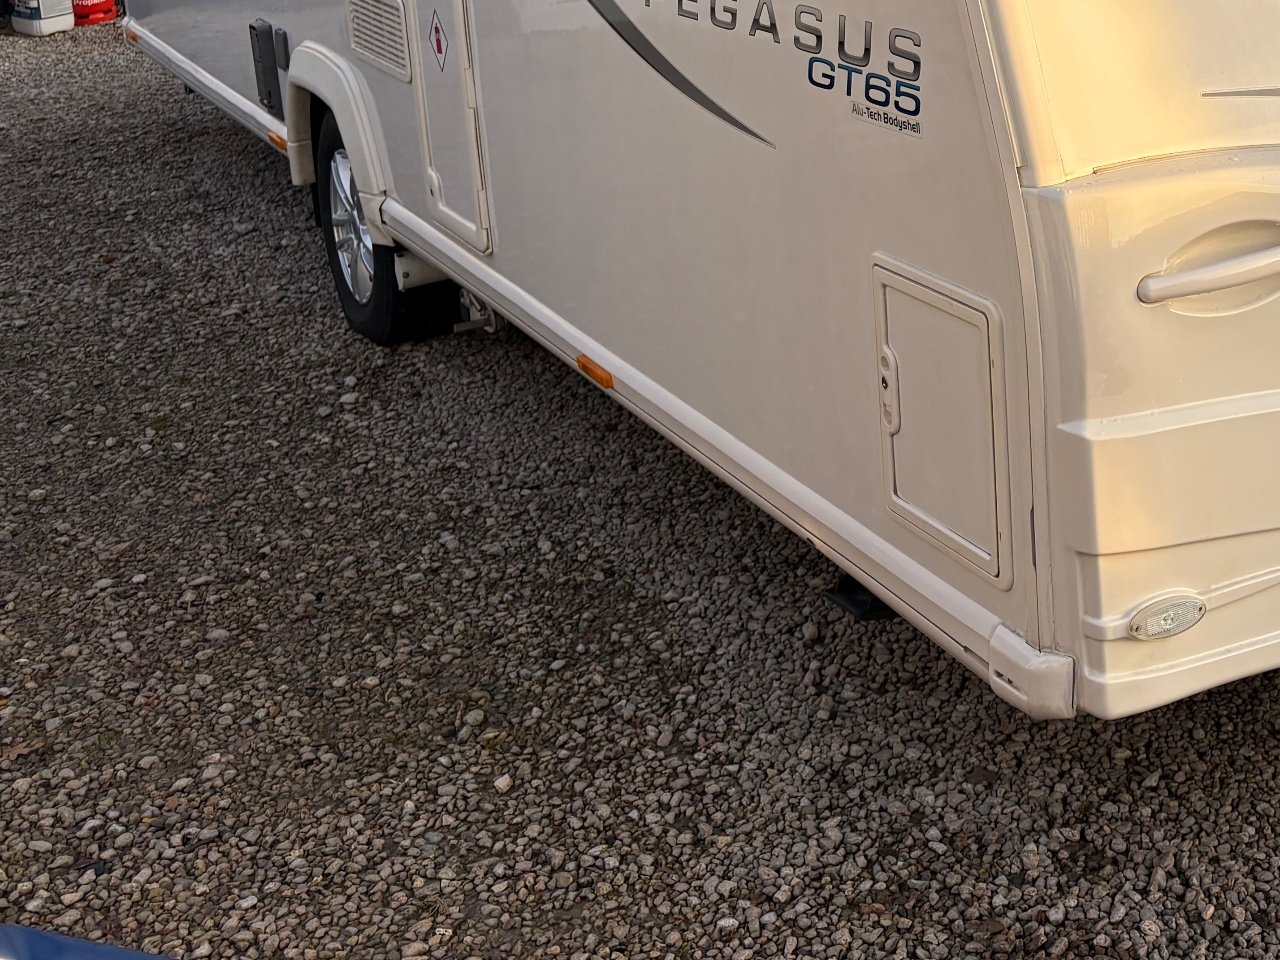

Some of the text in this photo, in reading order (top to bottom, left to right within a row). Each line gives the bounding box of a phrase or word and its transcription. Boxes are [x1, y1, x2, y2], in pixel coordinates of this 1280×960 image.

[807, 56, 922, 117] GT65
[851, 102, 921, 135] Alu-Tech Bodyshell
